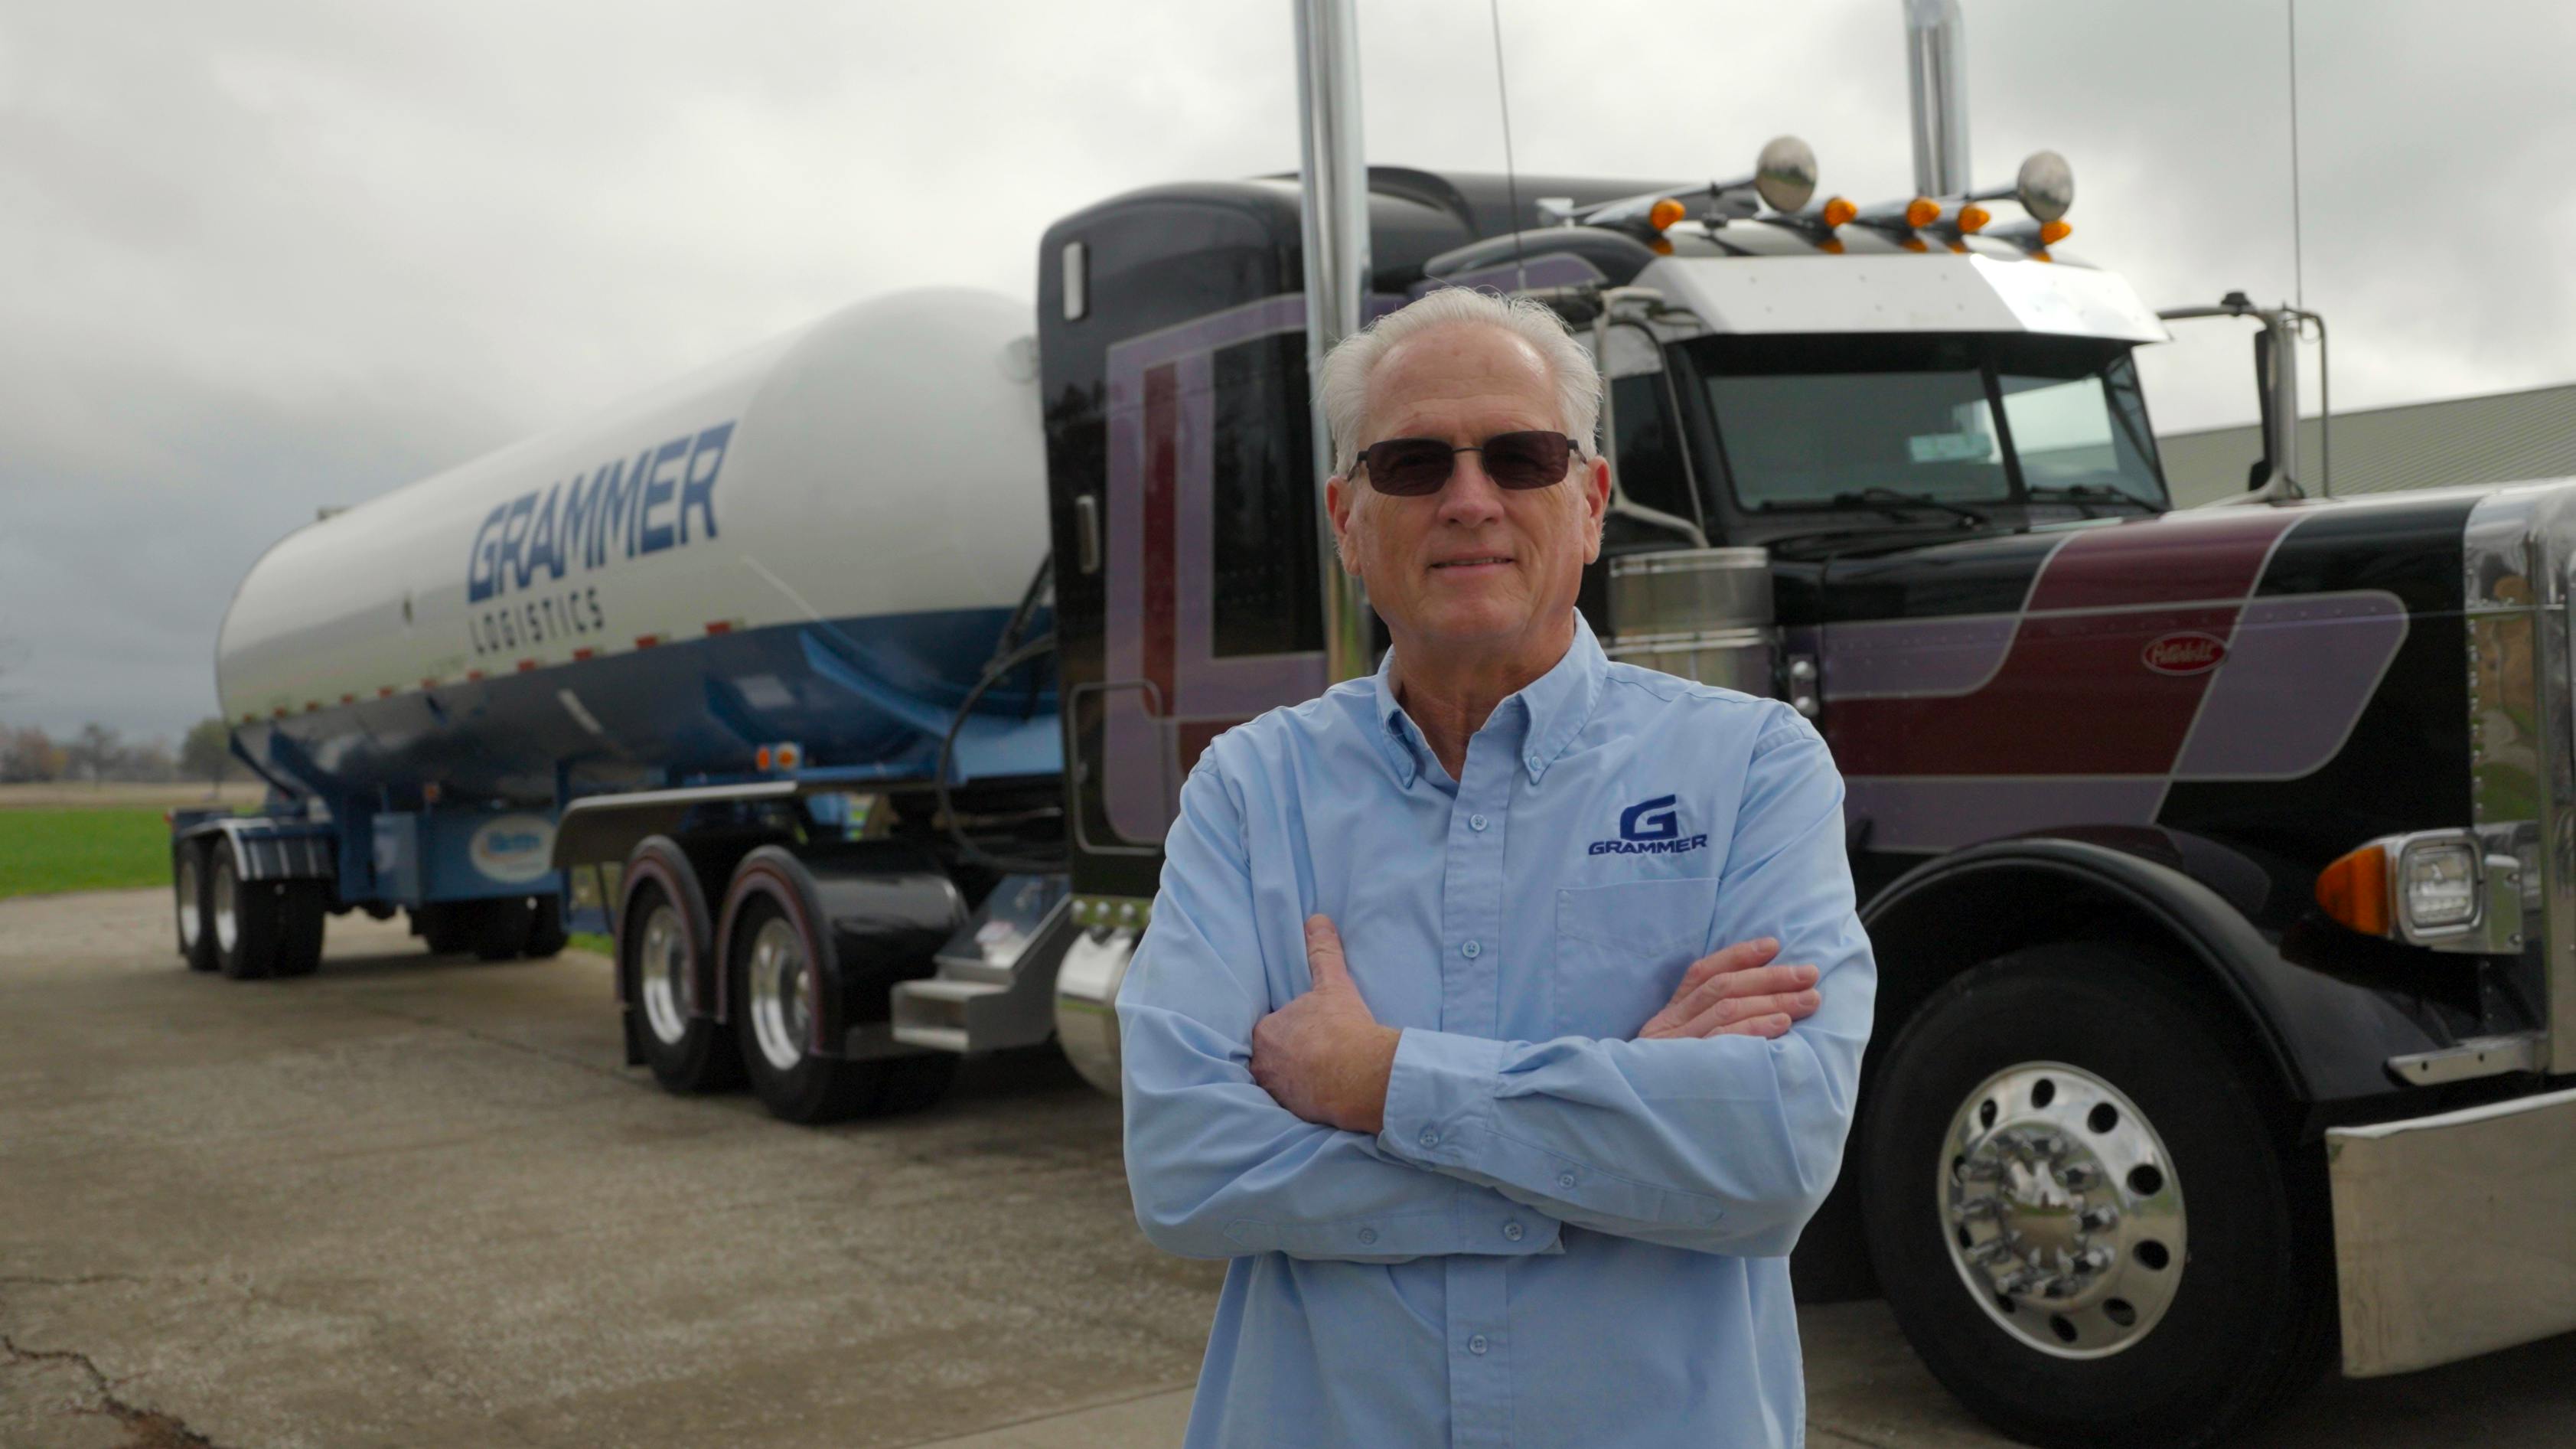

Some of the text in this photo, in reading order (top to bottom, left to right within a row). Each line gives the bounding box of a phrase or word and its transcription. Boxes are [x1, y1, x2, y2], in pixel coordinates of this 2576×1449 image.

[468, 419, 737, 603] GRAMMER
[469, 586, 603, 654] LOGISTICS
[1589, 834, 1707, 855] GRAMMER
[1620, 794, 1678, 841] G
